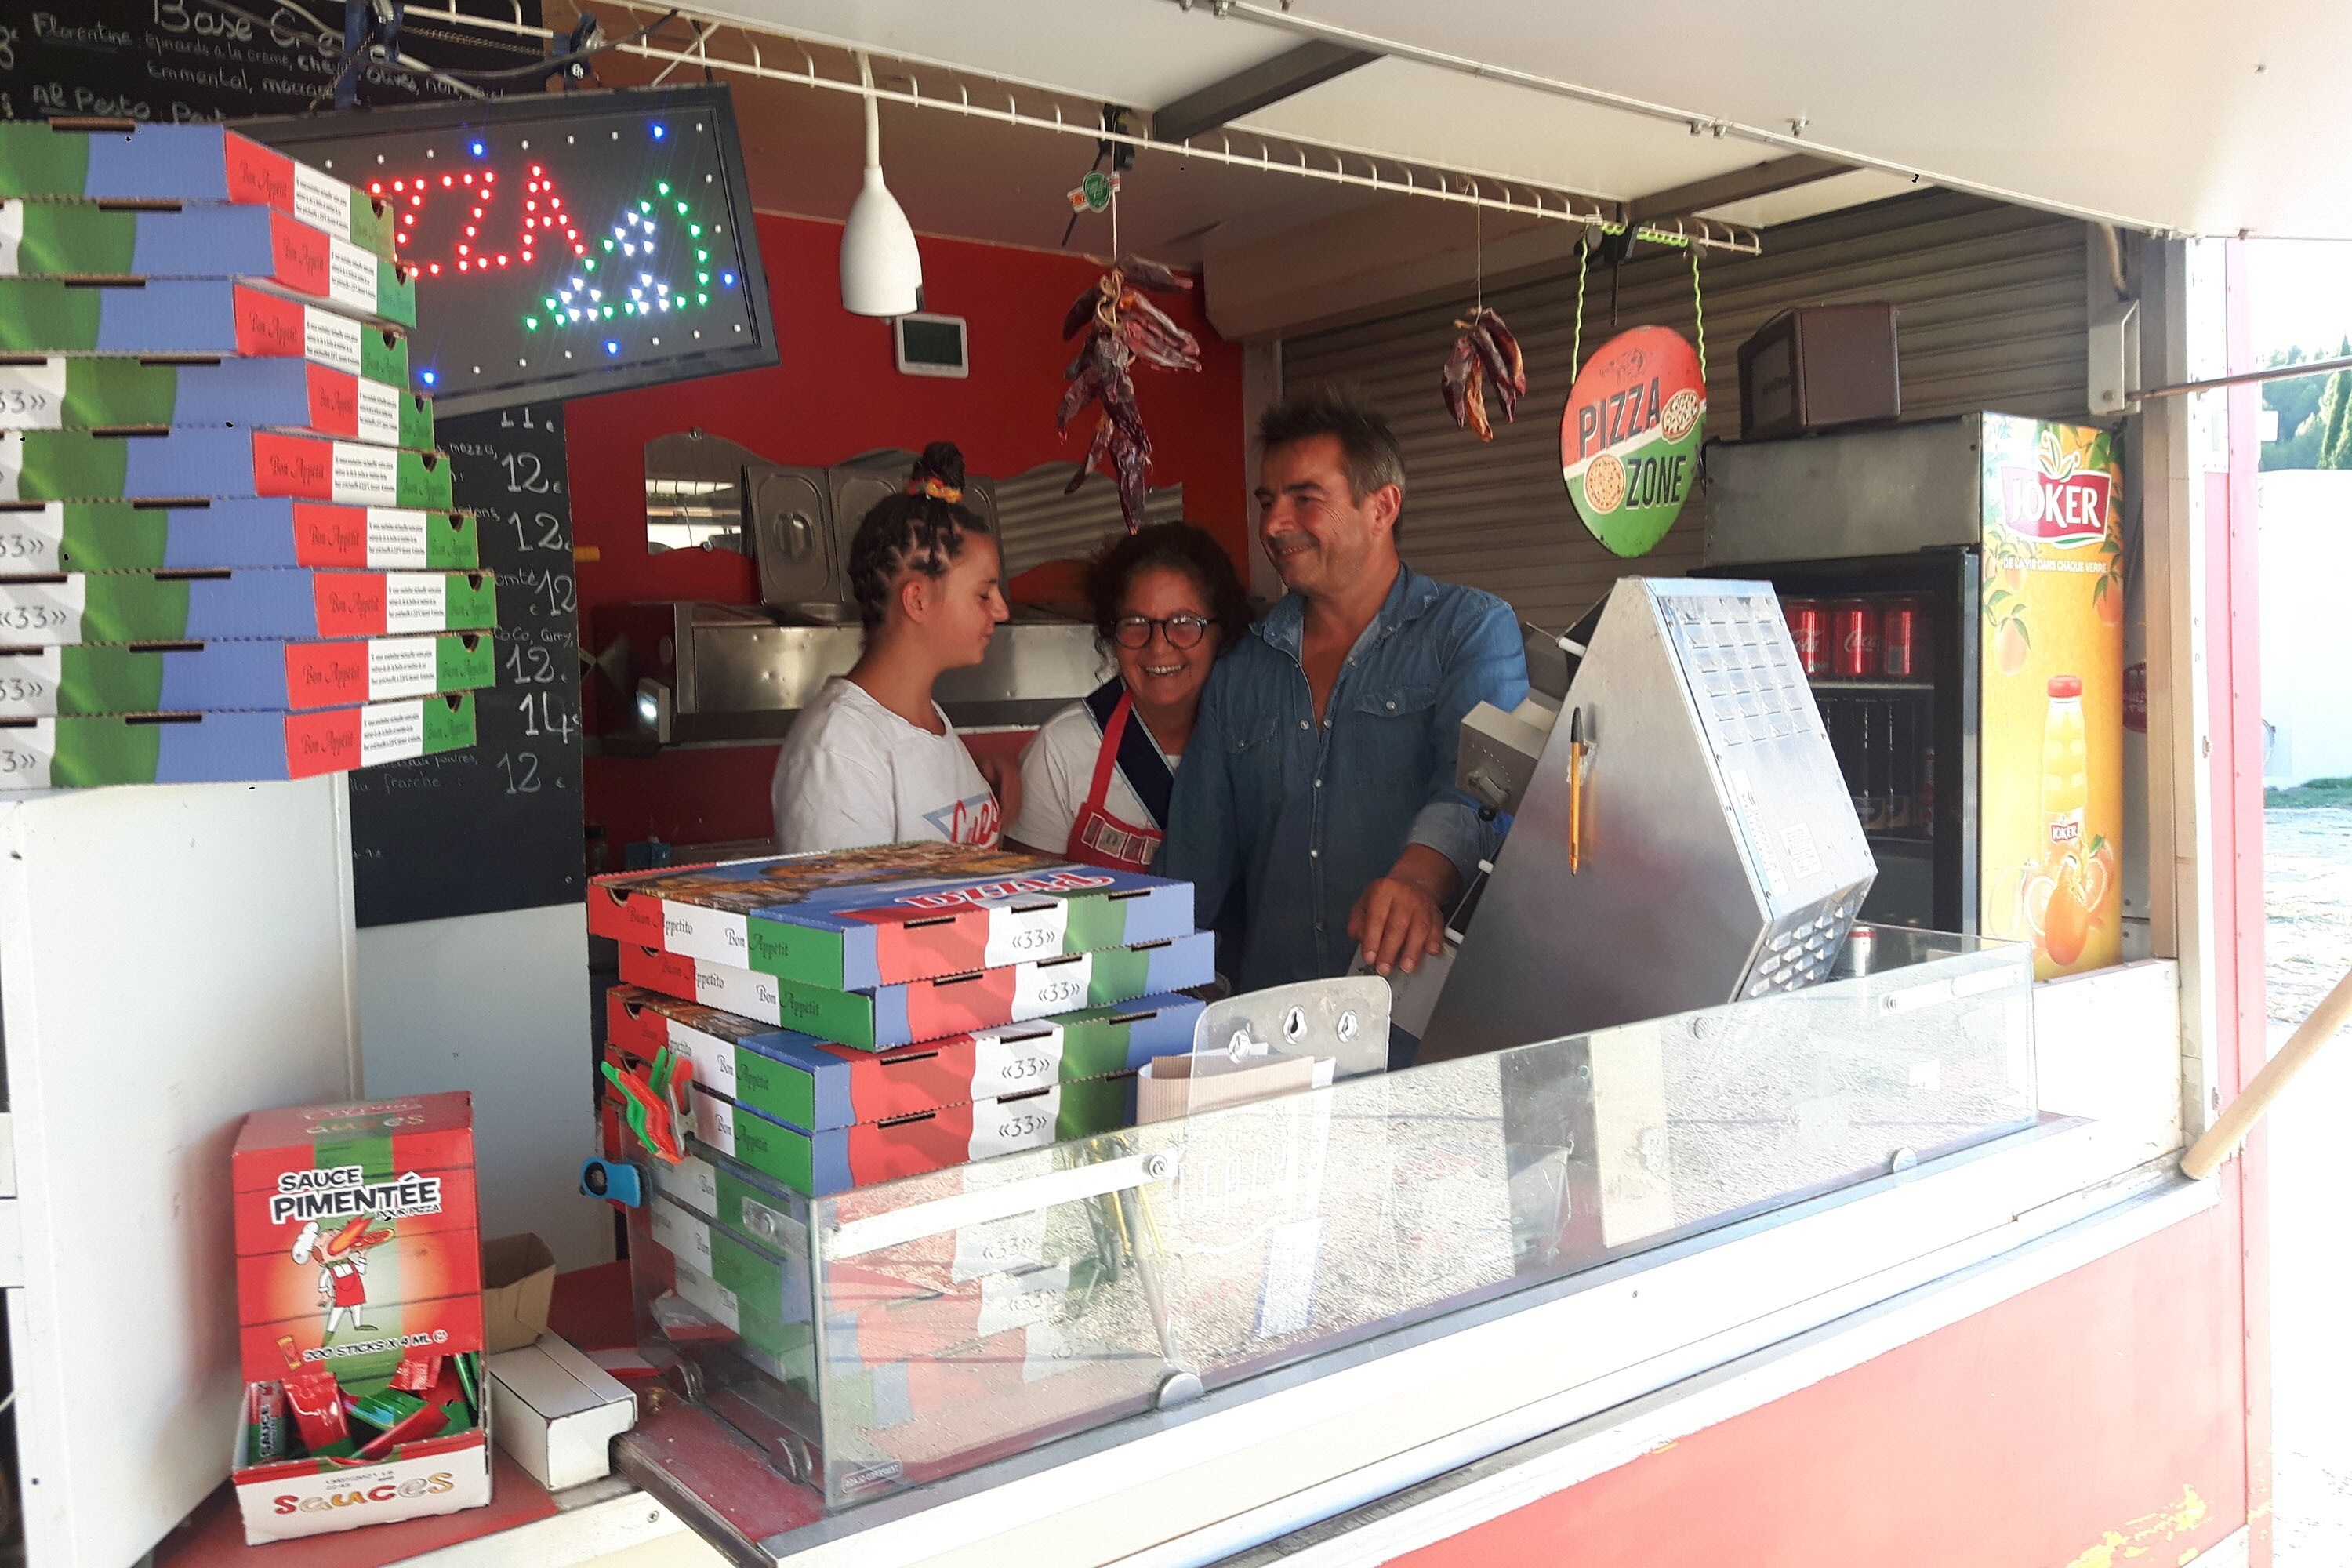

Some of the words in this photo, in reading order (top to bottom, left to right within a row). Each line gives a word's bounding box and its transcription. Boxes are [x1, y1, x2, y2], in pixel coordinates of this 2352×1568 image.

[1577, 376, 1661, 460] PIZZA
[1626, 454, 1687, 509] ZONE
[2011, 480, 2102, 528] JOKER
[508, 511, 564, 552] 12
[506, 644, 555, 685] 12
[518, 691, 574, 745] 14
[495, 751, 542, 795] 12
[724, 928, 746, 946] Bon
[756, 984, 777, 1004] Bon
[274, 1173, 437, 1221] PIMENTÉE
[280, 1167, 361, 1191] SAUCE
